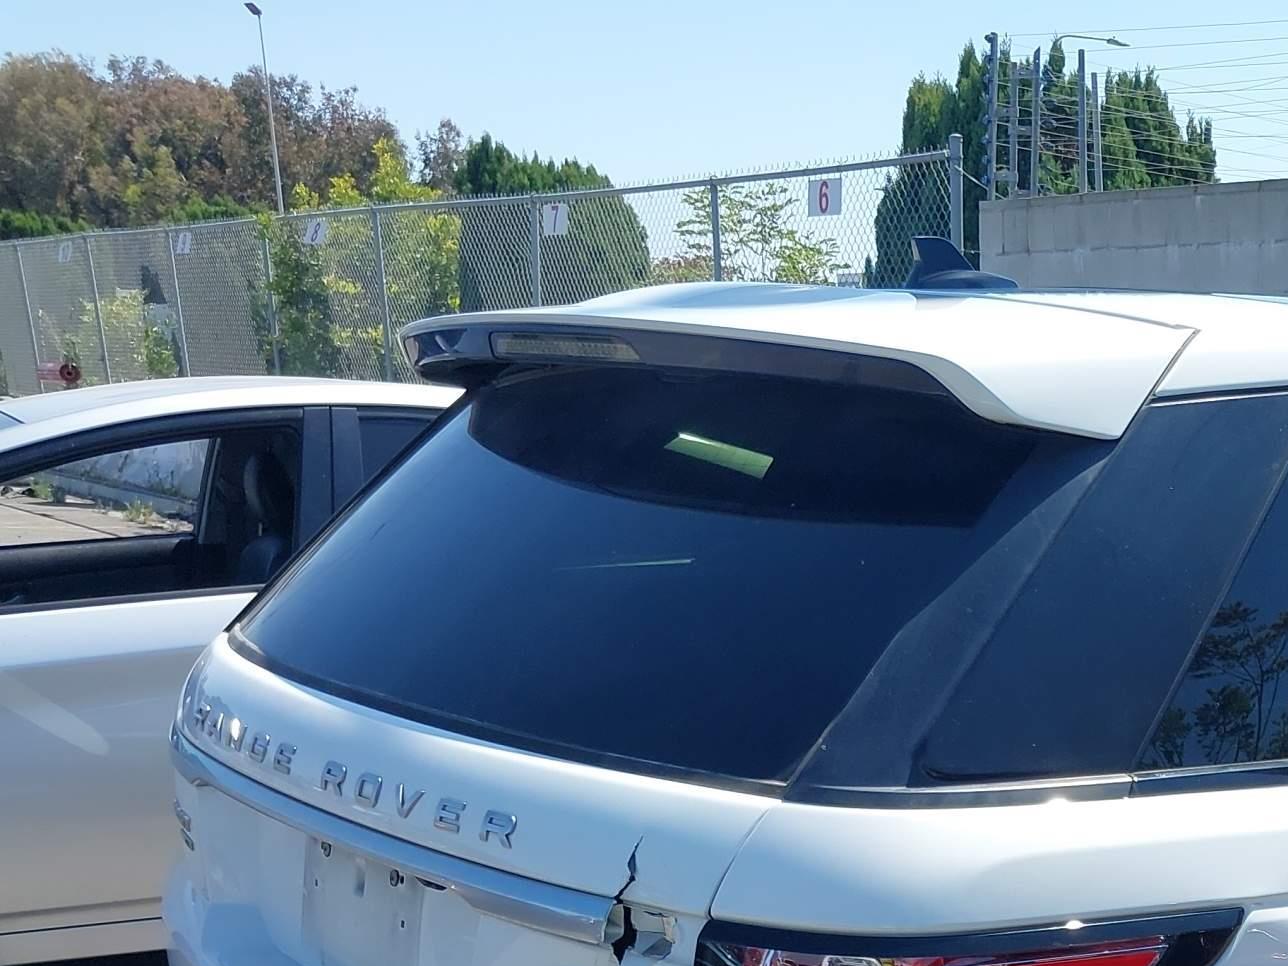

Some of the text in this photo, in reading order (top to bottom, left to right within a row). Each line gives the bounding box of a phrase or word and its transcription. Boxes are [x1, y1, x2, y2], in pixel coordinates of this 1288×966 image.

[818, 180, 829, 214] 6
[310, 222, 321, 242] 8
[551, 205, 559, 233] 7
[193, 702, 518, 850] RANGE ROVER
